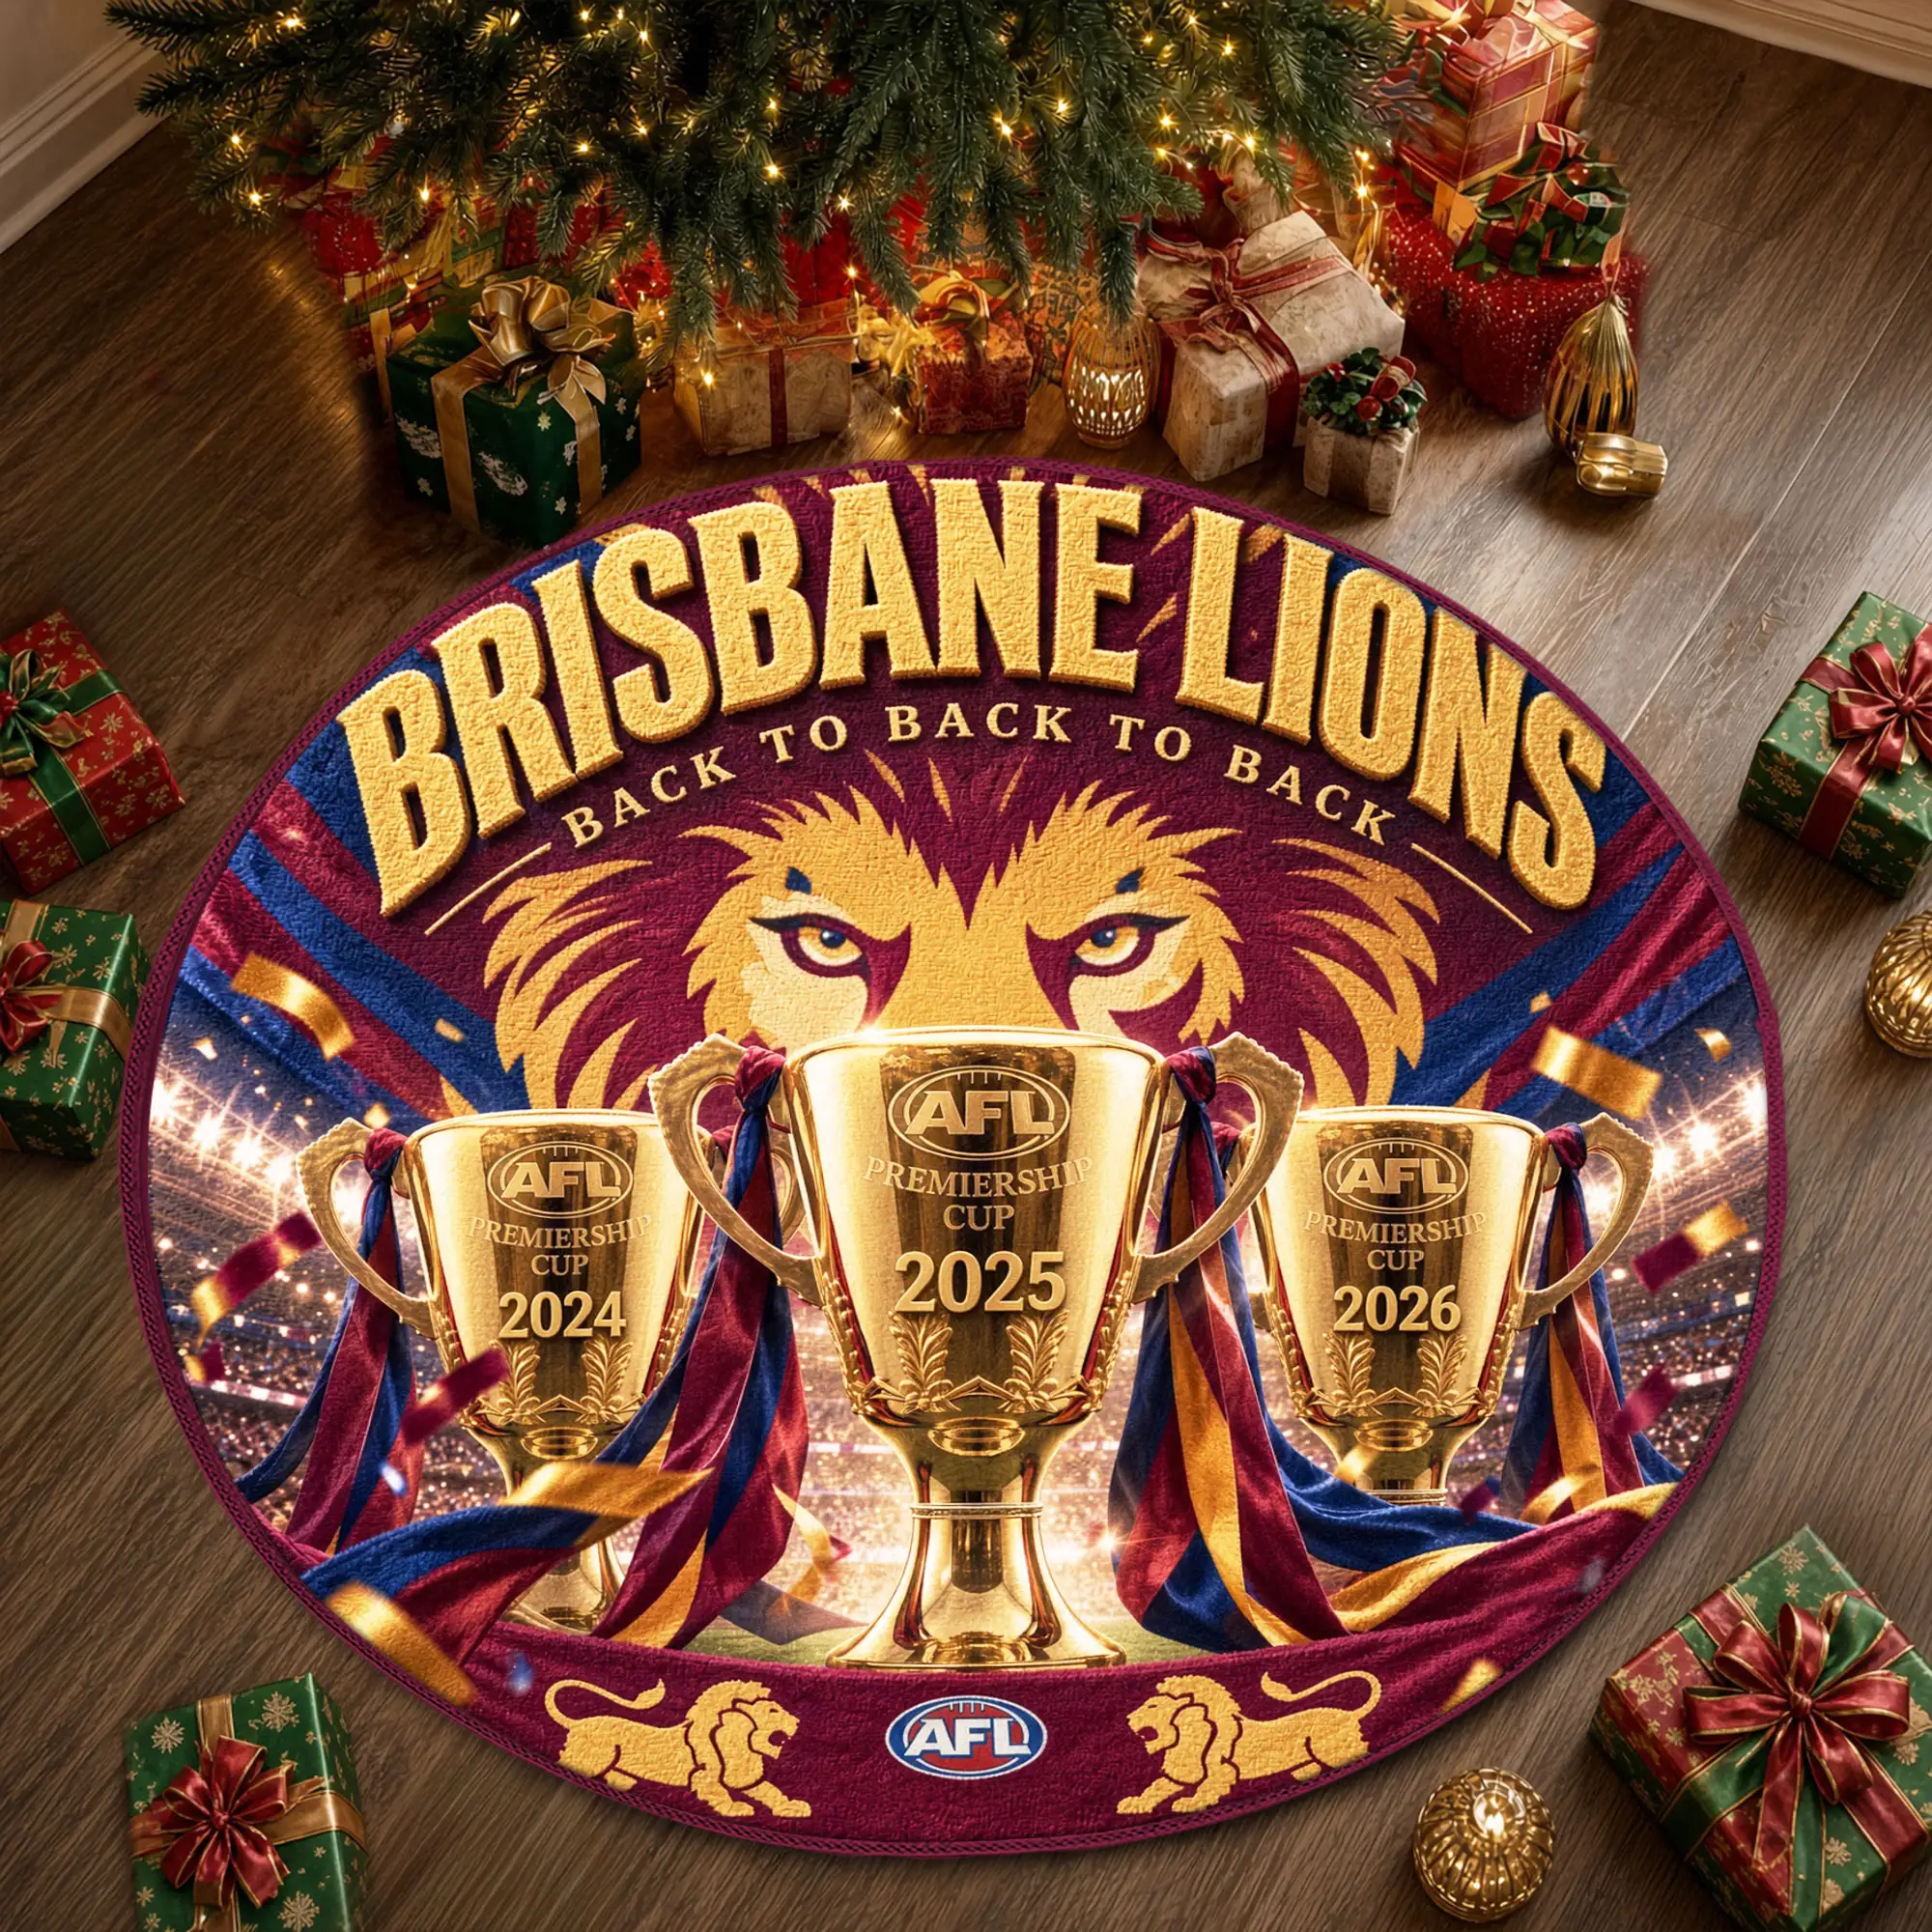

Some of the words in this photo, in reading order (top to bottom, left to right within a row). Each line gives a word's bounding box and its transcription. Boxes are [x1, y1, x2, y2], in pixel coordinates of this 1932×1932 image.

[335, 478, 1143, 916] BRISBANE
[1175, 506, 1606, 910] LIONS
[560, 745, 736, 848] BACK
[758, 715, 847, 763] TO
[886, 702, 1072, 743] BACK
[1109, 715, 1192, 761] TO
[1224, 745, 1397, 846] BACK
[904, 1091, 1055, 1135] AFL
[501, 1162, 622, 1198] AFL
[861, 1156, 1094, 1198] PREMIERSHIP
[1337, 1158, 1457, 1194] AFL
[465, 1214, 651, 1249] PREMIERSHIP
[943, 1205, 1014, 1231] CUP
[1302, 1210, 1487, 1244] PREMIERSHIP
[531, 1255, 589, 1276] CUP
[1367, 1249, 1425, 1271] CUP
[895, 1251, 1066, 1313] 2025
[498, 1291, 626, 1338] 2024
[1333, 1284, 1462, 1331] 2026
[904, 1719, 1032, 1756] AFL
